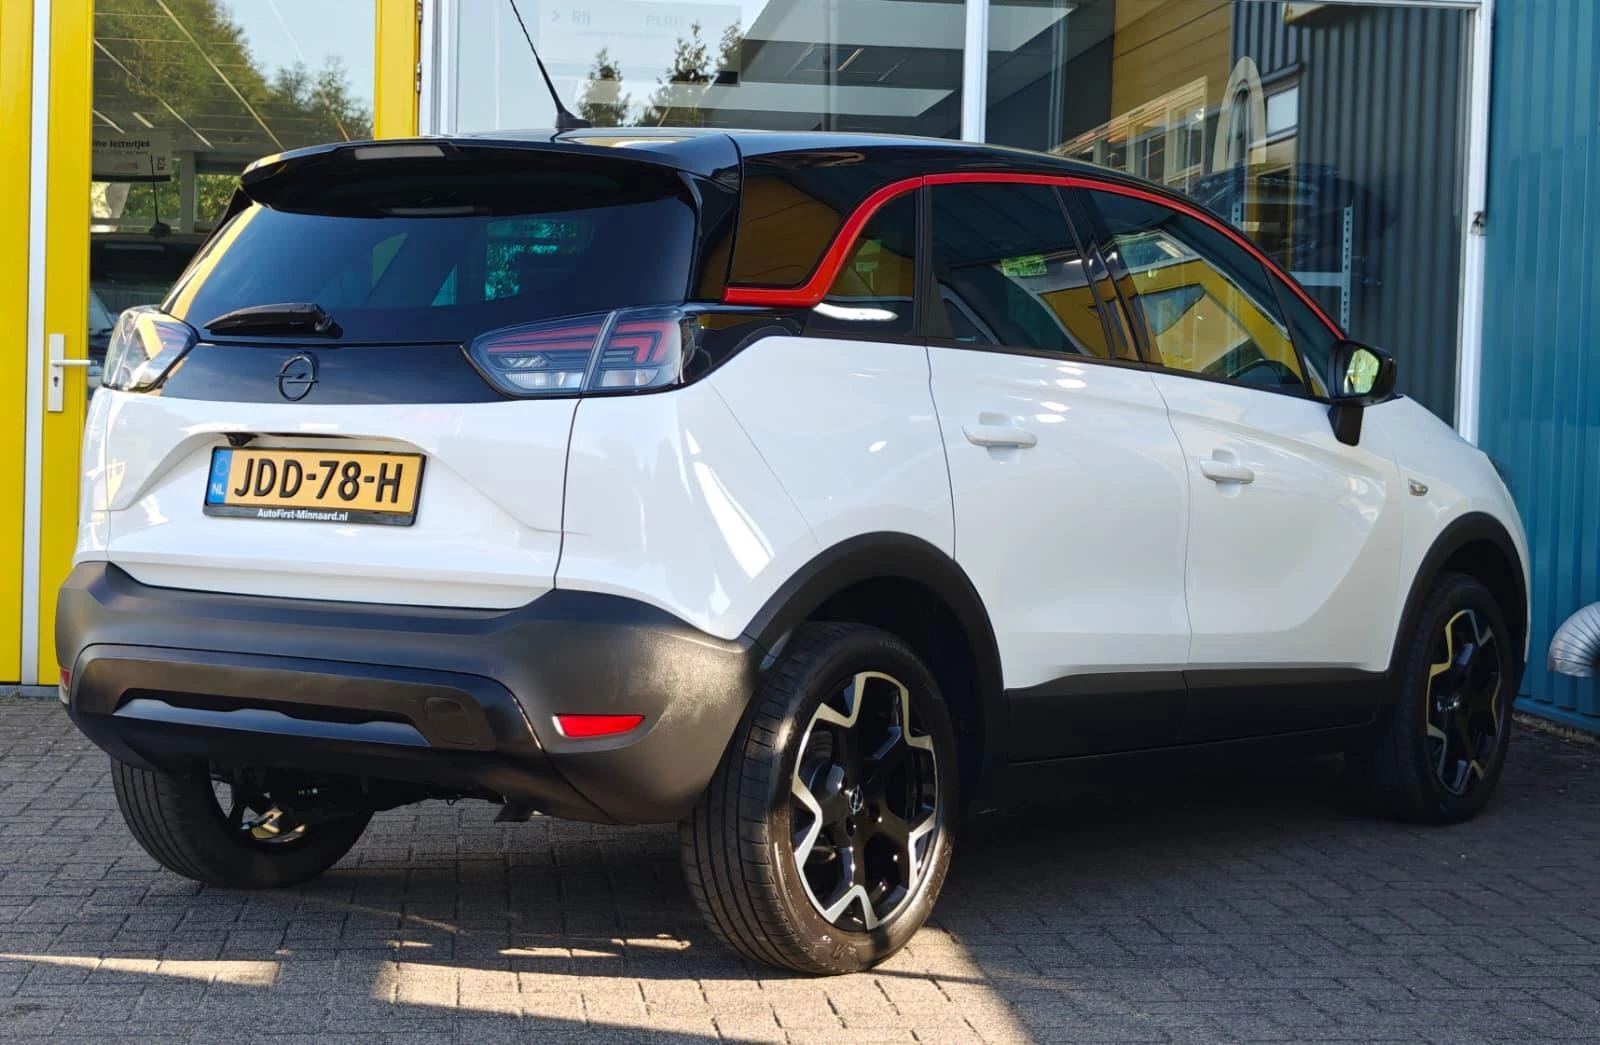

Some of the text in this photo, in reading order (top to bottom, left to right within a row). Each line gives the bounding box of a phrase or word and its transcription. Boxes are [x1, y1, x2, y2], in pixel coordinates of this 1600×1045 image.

[110, 140, 150, 149] lettertjes
[234, 458, 403, 503] JDD-78-H
[211, 483, 225, 496] NL
[257, 508, 349, 521] AutoFirst-Minnaard.nl
